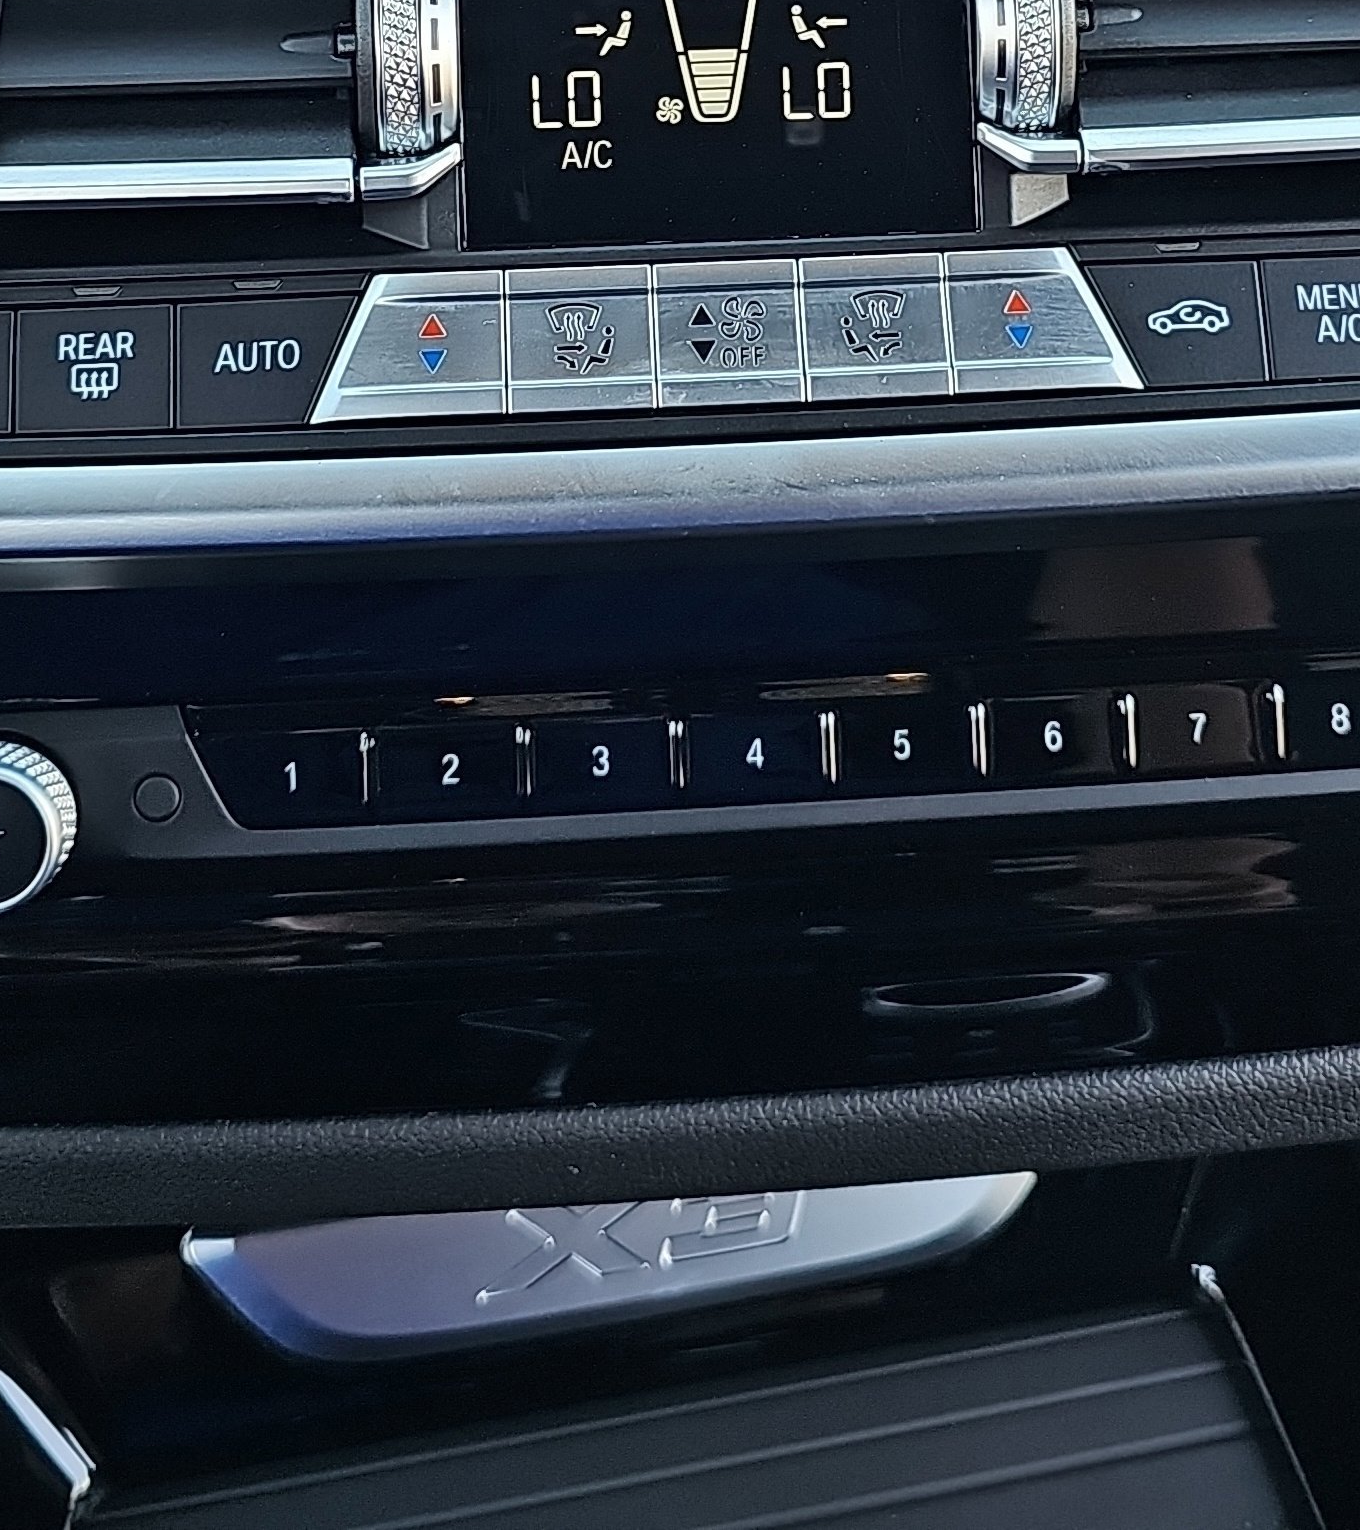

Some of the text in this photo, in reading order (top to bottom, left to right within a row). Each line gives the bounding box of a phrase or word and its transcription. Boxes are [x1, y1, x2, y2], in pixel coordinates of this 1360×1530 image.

[561, 140, 614, 170] A/C
[58, 332, 134, 361] REAR
[214, 340, 301, 372] AUTO
[719, 345, 767, 368] OFF
[283, 702, 1351, 793] 1 2 3 4 5 6 7 8
